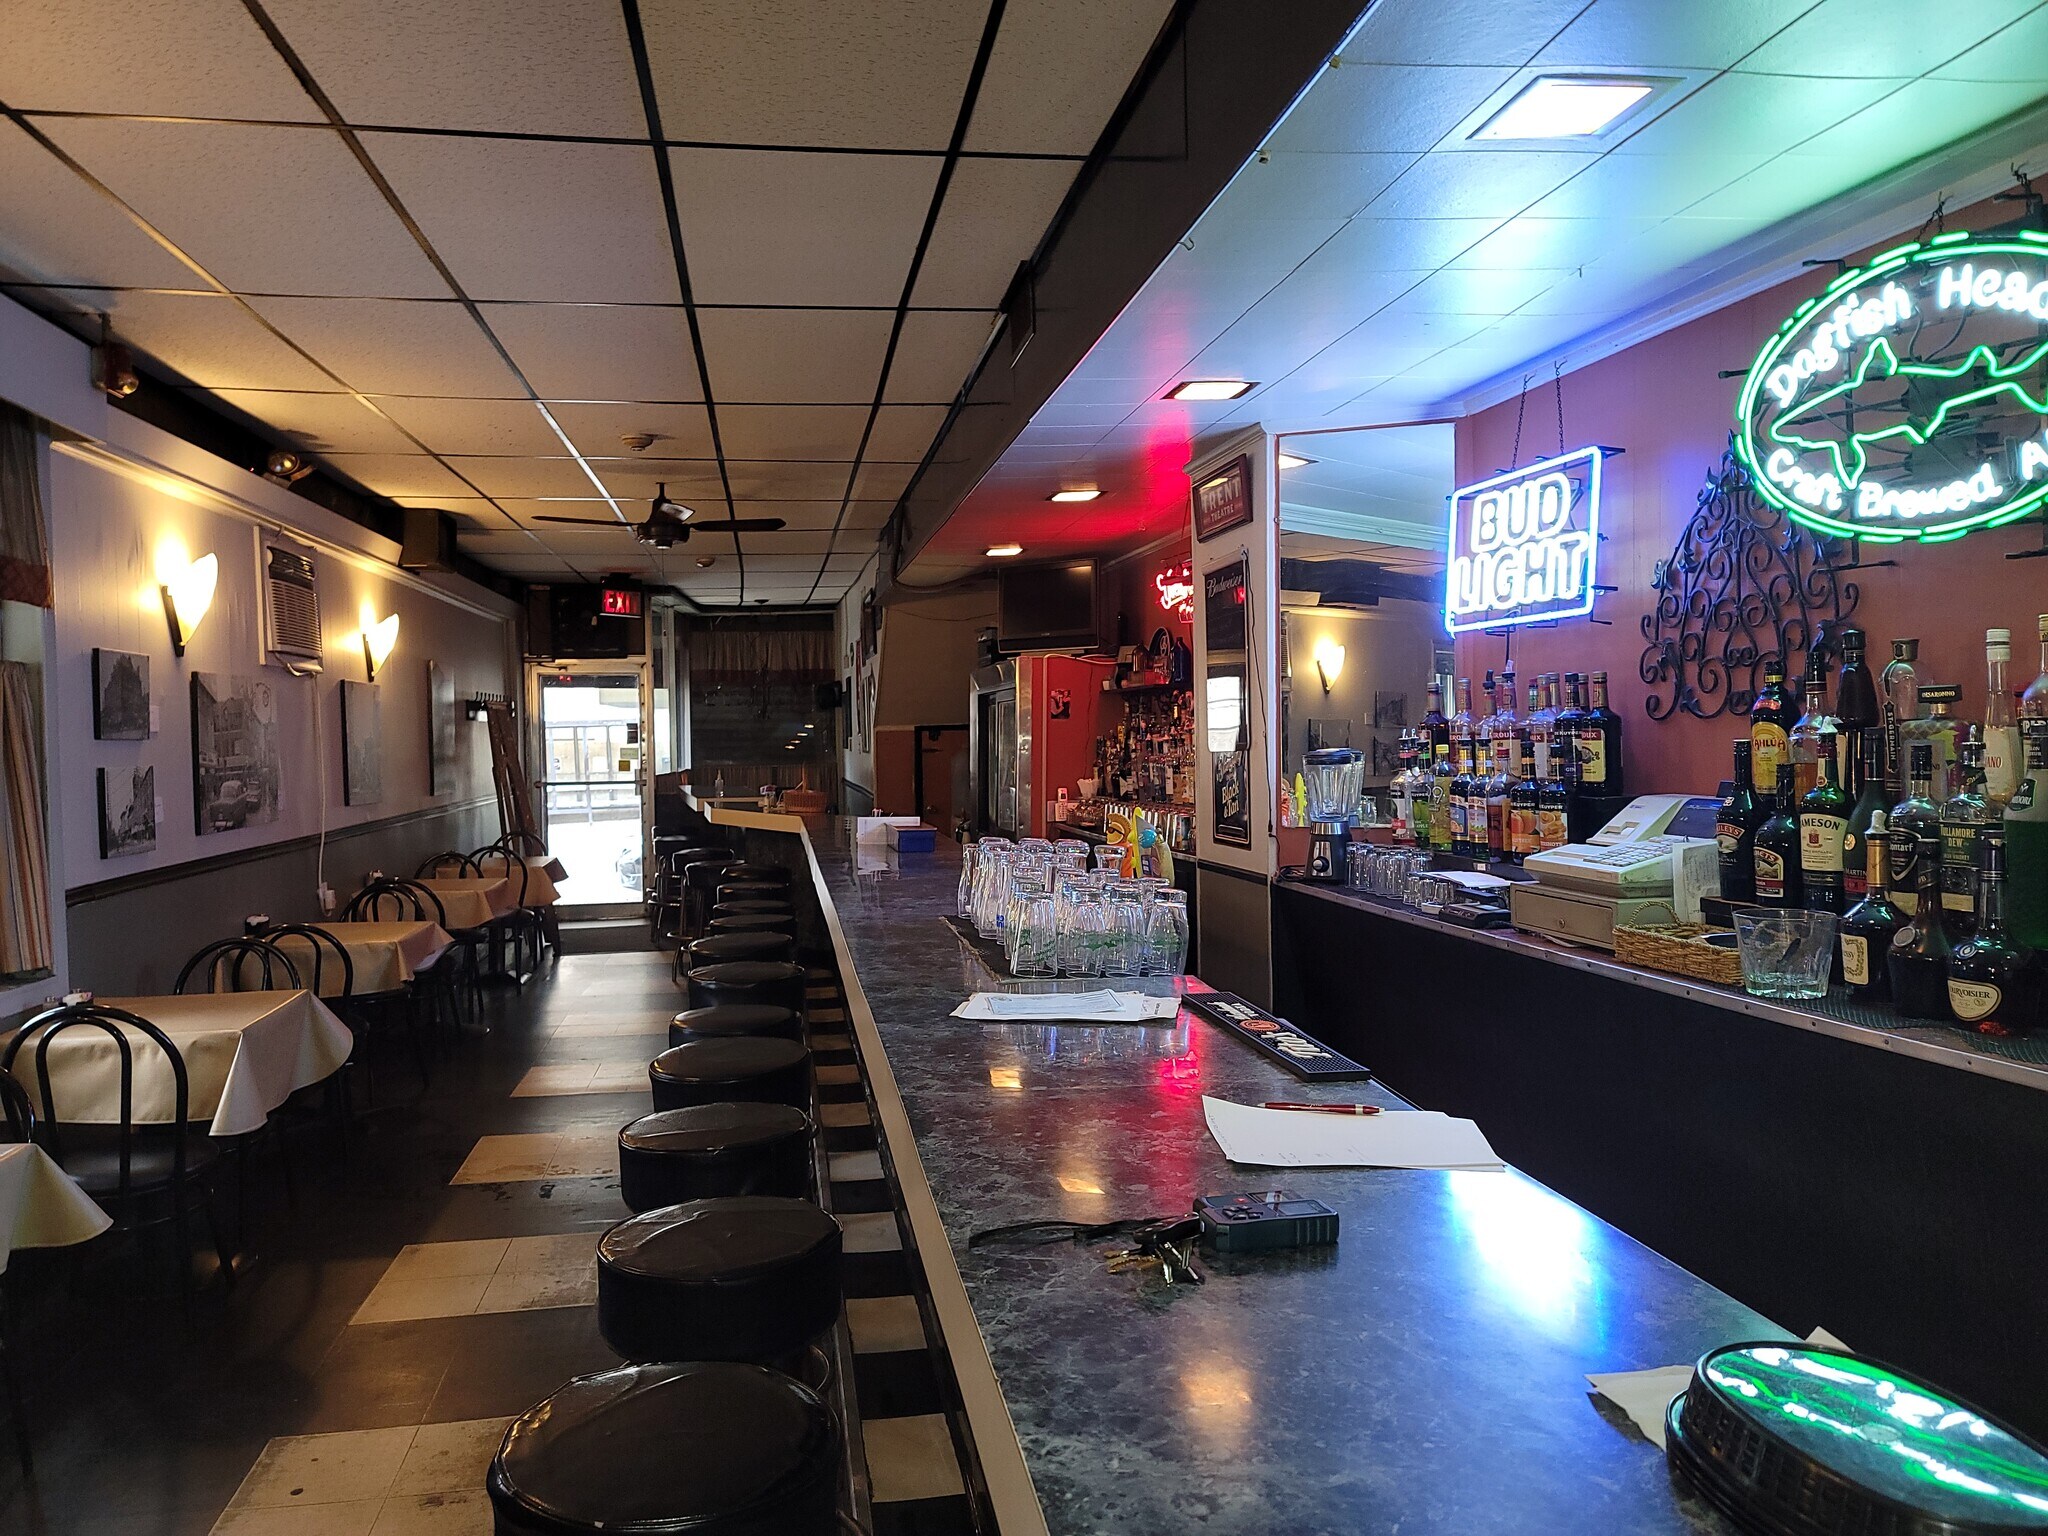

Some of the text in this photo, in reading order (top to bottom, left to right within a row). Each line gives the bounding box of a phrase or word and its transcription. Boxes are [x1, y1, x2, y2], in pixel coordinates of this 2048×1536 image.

[1766, 281, 1911, 408] Dogfish
[1767, 448, 1842, 511] Craft
[1858, 463, 2003, 518] Brewed
[1201, 477, 1241, 513] TRENT
[1211, 503, 1234, 522] THEATRE
[1471, 472, 1571, 553] BUD
[1451, 530, 1589, 615] LIGHT
[1207, 573, 1242, 598] Budweiser
[1922, 690, 1956, 698] DISARONNO
[1754, 736, 1786, 751] AHLÚA
[1802, 818, 1840, 831] AMESON
[1940, 824, 1976, 839] TULLAMORE
[1948, 838, 1964, 847] DEW
[1950, 987, 1991, 999] URVOISIER
